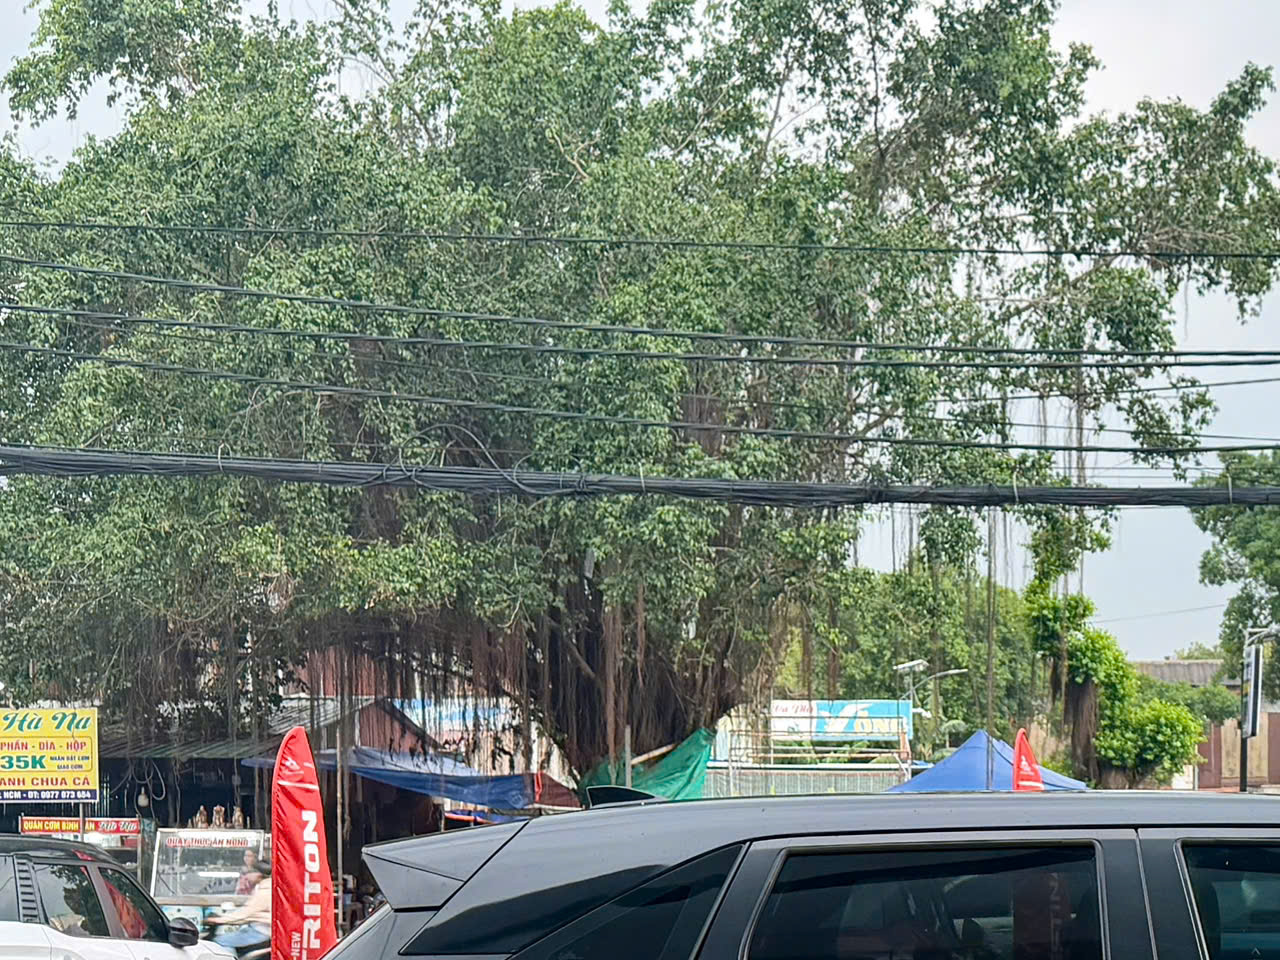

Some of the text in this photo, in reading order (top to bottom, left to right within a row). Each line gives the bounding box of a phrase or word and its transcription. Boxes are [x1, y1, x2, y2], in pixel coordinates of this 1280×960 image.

[0, 755, 46, 770] 35K
[31, 777, 68, 786] CHUA
[4, 791, 21, 799] HCM
